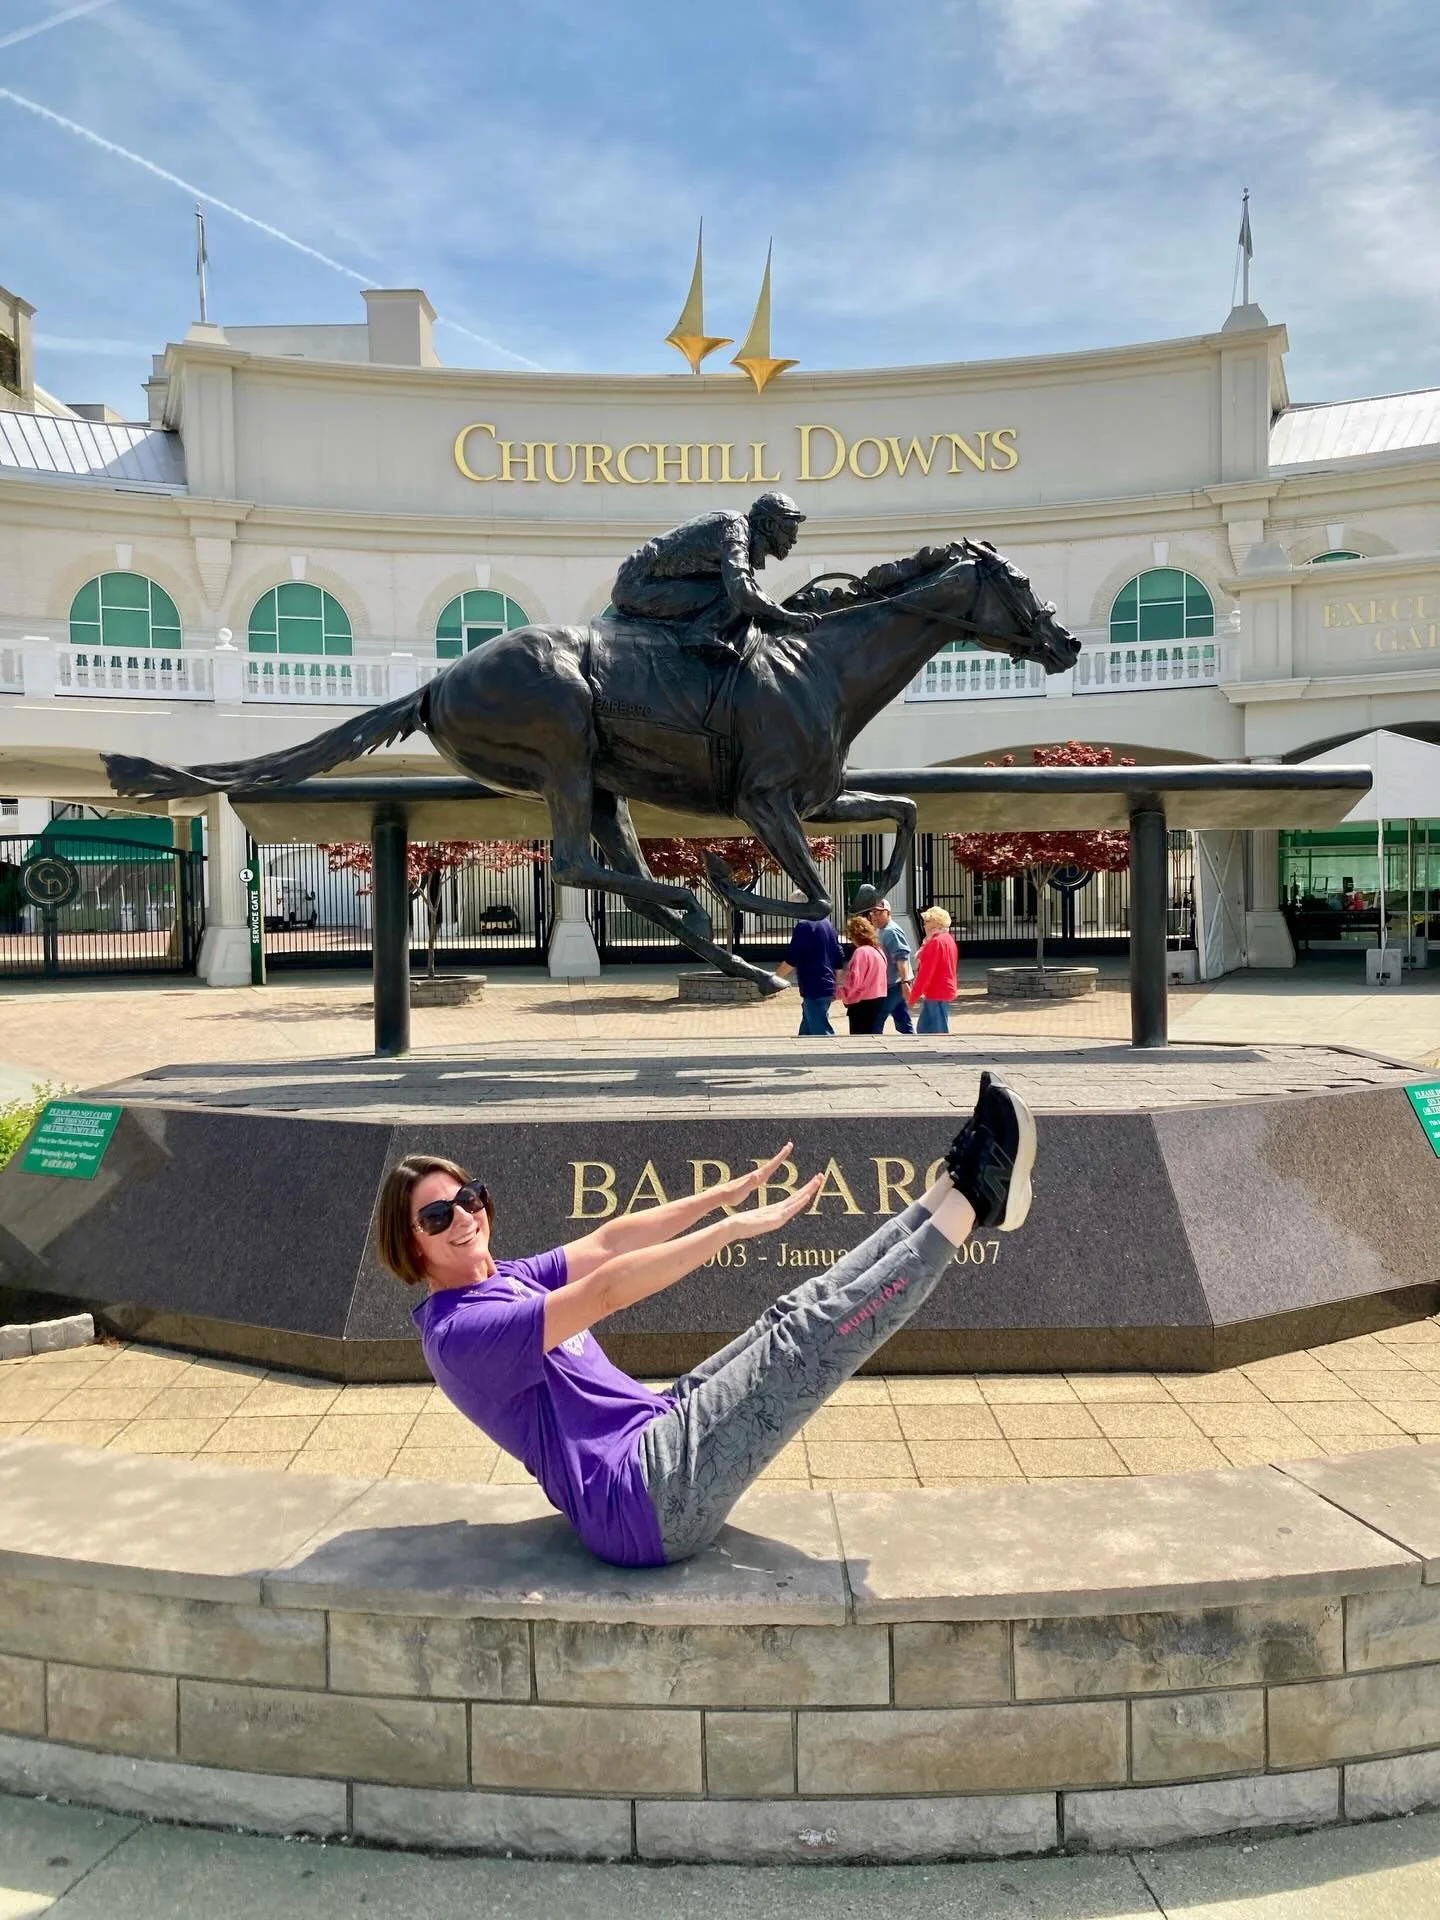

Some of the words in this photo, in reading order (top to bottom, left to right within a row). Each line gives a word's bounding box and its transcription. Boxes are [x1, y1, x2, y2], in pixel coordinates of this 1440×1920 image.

[453, 422, 781, 485] CHURCHILL
[794, 423, 1019, 480] DOWNS
[1321, 596, 1440, 628] EXECU
[1375, 622, 1440, 652] GAT
[251, 890, 259, 911] GATE
[252, 911, 260, 944] SERVICE
[776, 1242, 849, 1267] Janua
[949, 1241, 1000, 1265] 007
